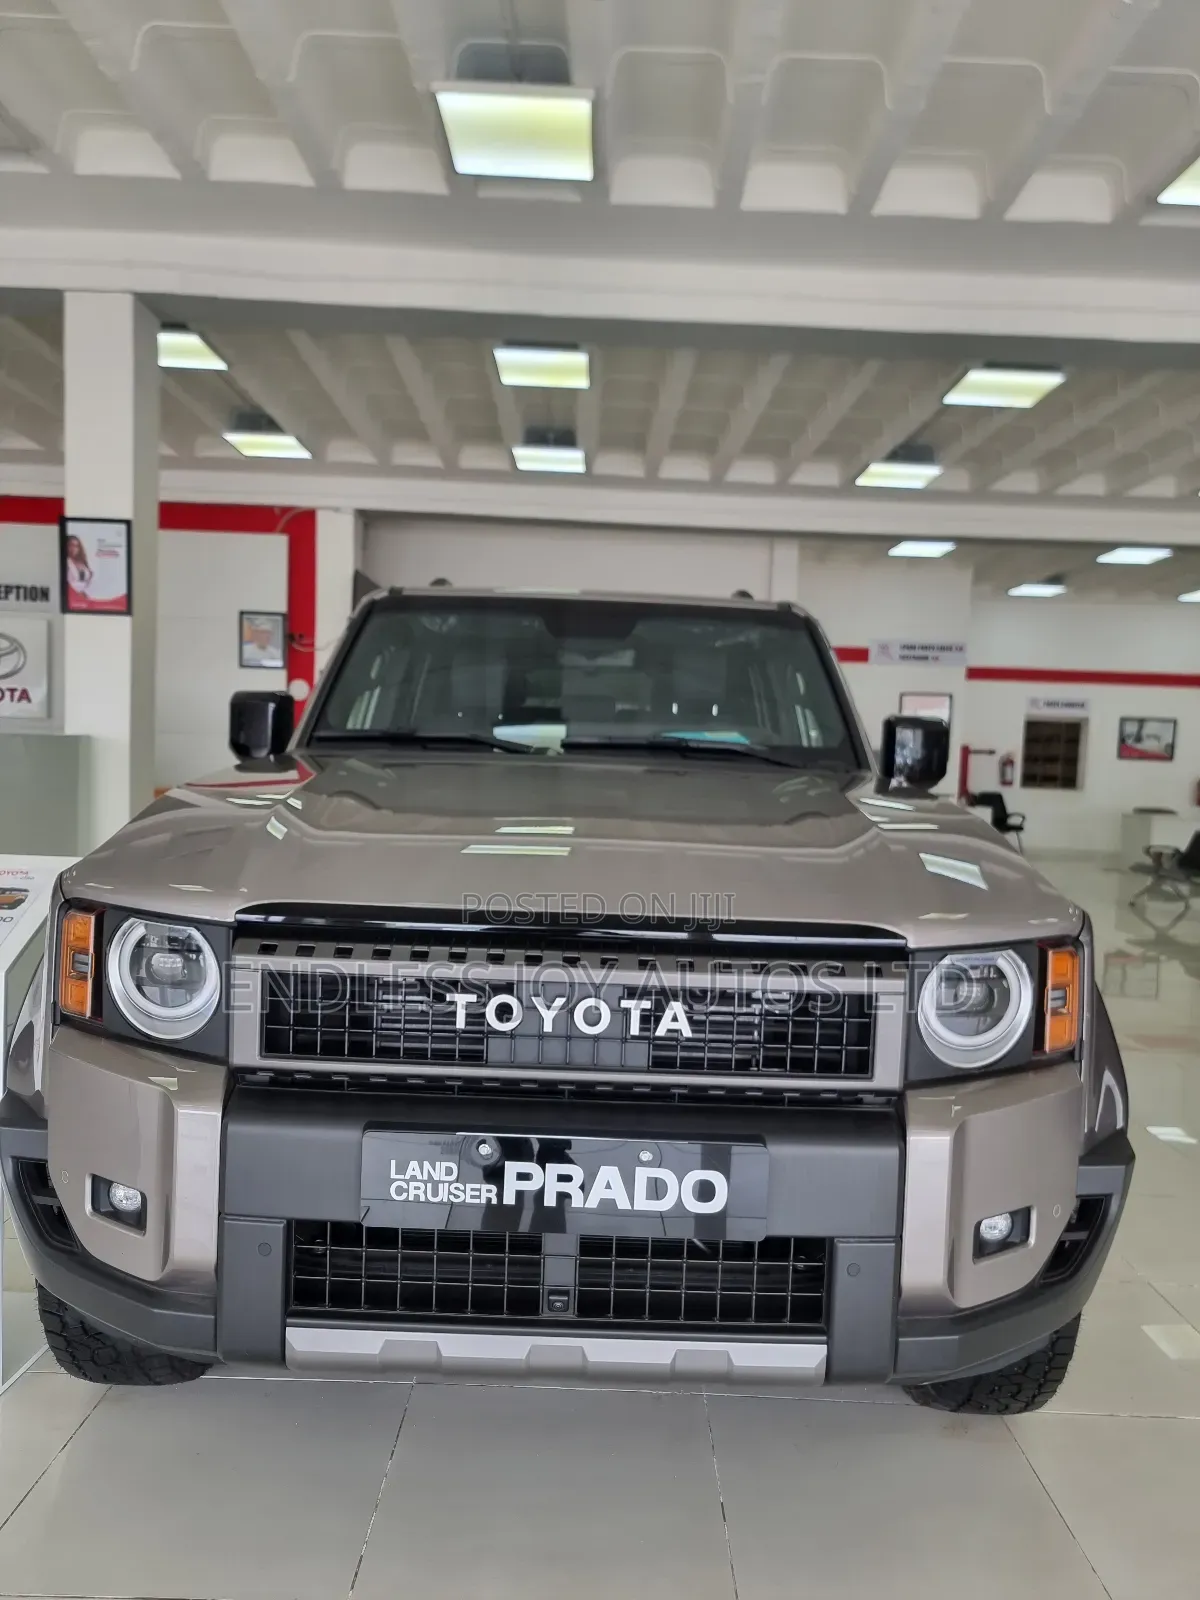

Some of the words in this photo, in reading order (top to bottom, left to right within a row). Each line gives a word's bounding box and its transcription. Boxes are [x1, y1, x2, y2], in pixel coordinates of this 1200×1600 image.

[446, 993, 693, 1038] TOYOTA
[389, 1159, 459, 1182] LAND
[502, 1160, 729, 1215] PRADO
[389, 1181, 498, 1205] CRUISER
